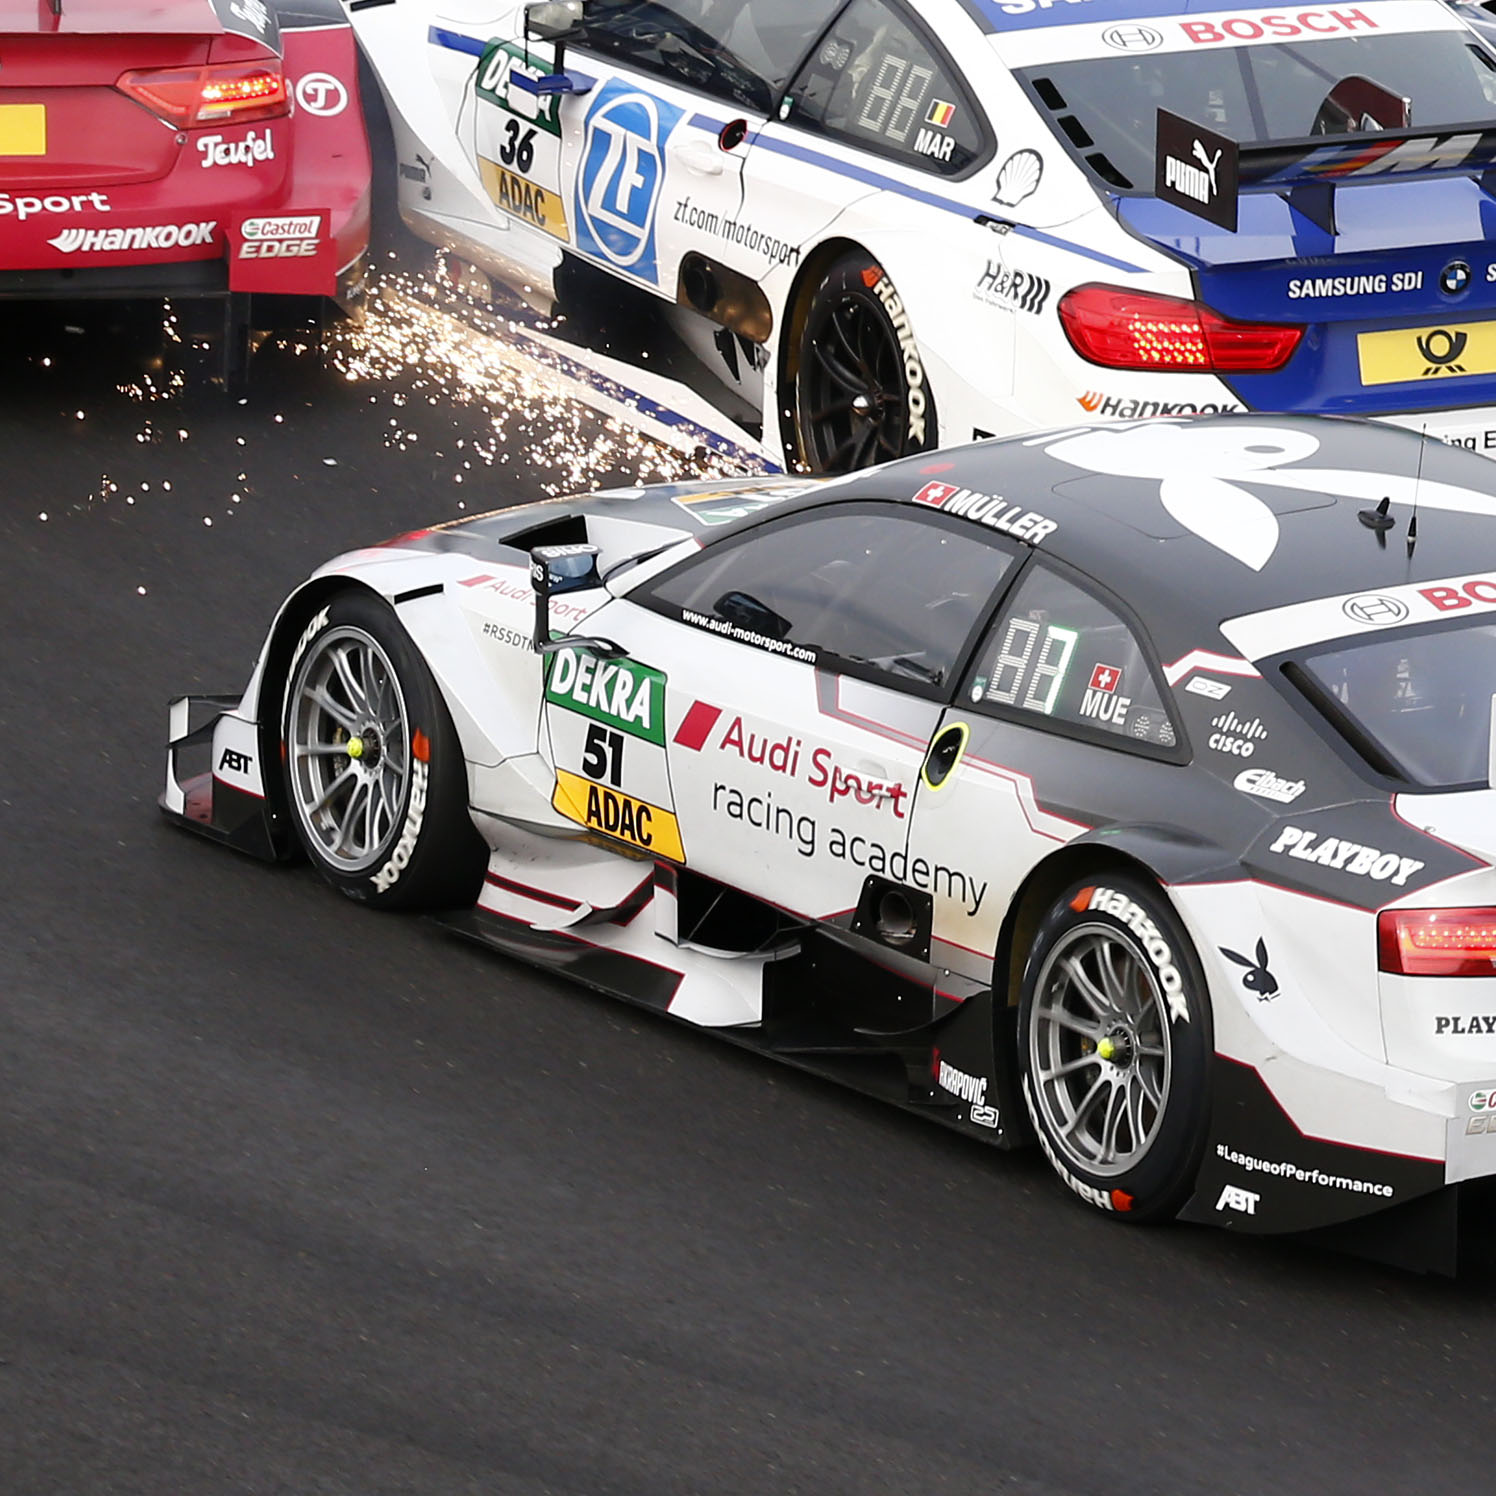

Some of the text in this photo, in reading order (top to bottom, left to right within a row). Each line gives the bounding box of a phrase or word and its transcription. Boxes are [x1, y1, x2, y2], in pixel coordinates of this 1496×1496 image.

[1178, 8, 1380, 45] BOSCH
[197, 128, 275, 168] Teufel
[500, 118, 538, 174] 36
[913, 127, 956, 162] MAR
[1342, 134, 1483, 178] M
[499, 169, 547, 227] ADAC
[1165, 155, 1210, 205] PUMA
[238, 238, 321, 260] EDGE
[260, 217, 315, 237] Castrol
[672, 196, 801, 268] zf.com/motorsport
[1287, 270, 1424, 300] SAMSUNG SDI
[943, 488, 1058, 547] MÜLLER
[489, 578, 532, 601] Audi
[682, 608, 817, 664] www.audi-motorsport.com
[550, 648, 651, 730] DEKRA
[1078, 689, 1133, 727] MUE
[218, 747, 253, 775] ABT
[581, 722, 625, 789] 51
[719, 716, 908, 819] Audi Sport
[585, 784, 653, 848] ADAC
[712, 780, 989, 917] racing academy
[1268, 823, 1425, 887] PLAYBOY
[1216, 1143, 1395, 1198] #LeagueofPerformance
[1216, 1184, 1262, 1216] ABT
